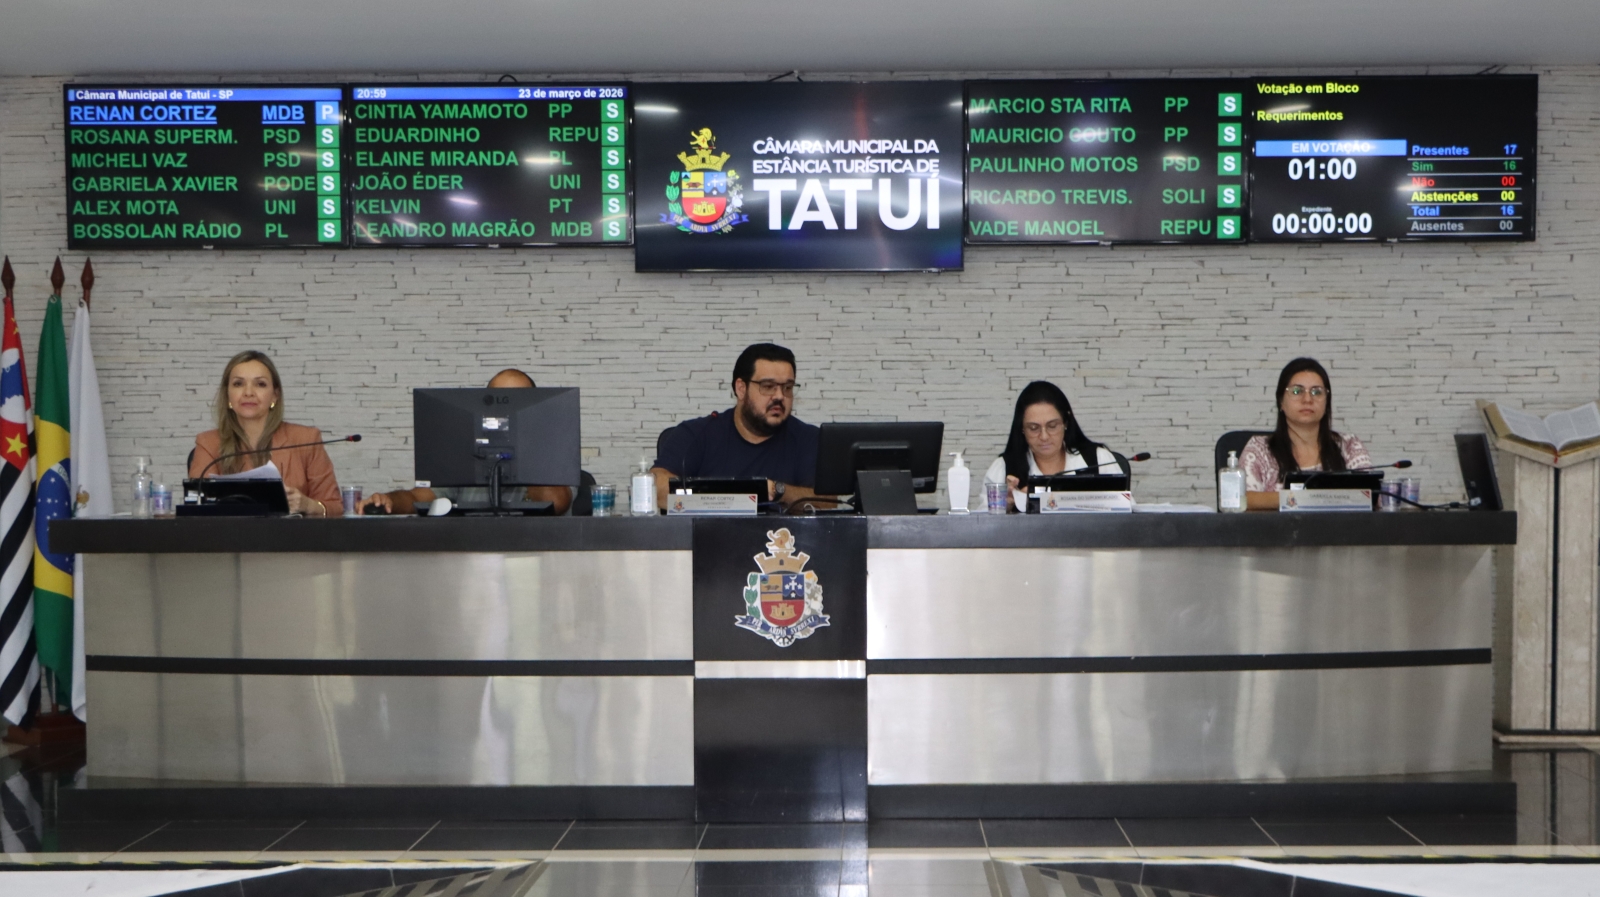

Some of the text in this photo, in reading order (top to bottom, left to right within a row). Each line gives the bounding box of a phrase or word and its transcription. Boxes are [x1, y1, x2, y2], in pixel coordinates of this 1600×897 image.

[76, 90, 116, 99] Câmara
[118, 90, 167, 101] Municipal
[170, 91, 182, 99] de
[219, 91, 234, 99] SP
[357, 88, 623, 99] 20:59 23 de março de 2026
[1257, 83, 1359, 94] Votação em Bloco
[355, 104, 618, 119] CINTIA YAMAMOTO PP S
[970, 97, 1236, 113] MARCIO STA RITA PP S
[70, 105, 333, 121] RENAN CORTEZ MDB P
[1257, 110, 1343, 122] Requerimentos
[71, 130, 333, 144] ROSANA SUPERM. PSD S
[356, 127, 619, 142] EDUARDINHO REPU S
[970, 127, 1236, 143] MAURICIO COUTO PP S
[753, 137, 939, 155] CÂMARA MUNICIPAL DA
[1292, 141, 1370, 155] EM VOTAÇÃO
[1412, 145, 1517, 155] Presentes 17
[72, 153, 334, 167] MICHELI VAZ PSD S
[356, 151, 619, 166] ELAINE MIRANDA PL S
[753, 156, 939, 174] ESTÂNCIA TURÍSTICA DE
[970, 157, 1235, 173] PAULINHO MOTOS PSD S
[1412, 161, 1516, 171] Sim 16
[1288, 158, 1357, 180] 01:00
[72, 177, 334, 191] GABRIELA XAVIER PODE S
[355, 172, 619, 190] JOÃO ÉDER UNI S
[1412, 176, 1515, 187] Não 00
[753, 172, 940, 231] TATUÍ
[970, 189, 1235, 205] RICARDO TREVIS. SOLI S
[1411, 190, 1515, 203] Abstenções 00
[73, 200, 335, 215] ALEX MOTA UNI S
[356, 199, 620, 214] KELVIN PT S
[1412, 206, 1514, 216] Total 16
[74, 221, 335, 239] BOSSOLAN RÁDIO PL S
[356, 219, 620, 238] LEANDRO MAGRÃO MDB S
[970, 220, 1234, 235] VADE MANOEL REPU S
[1272, 213, 1372, 234] 00:00:00
[1411, 220, 1513, 231] Ausentes 00
[497, 396, 509, 404] LG
